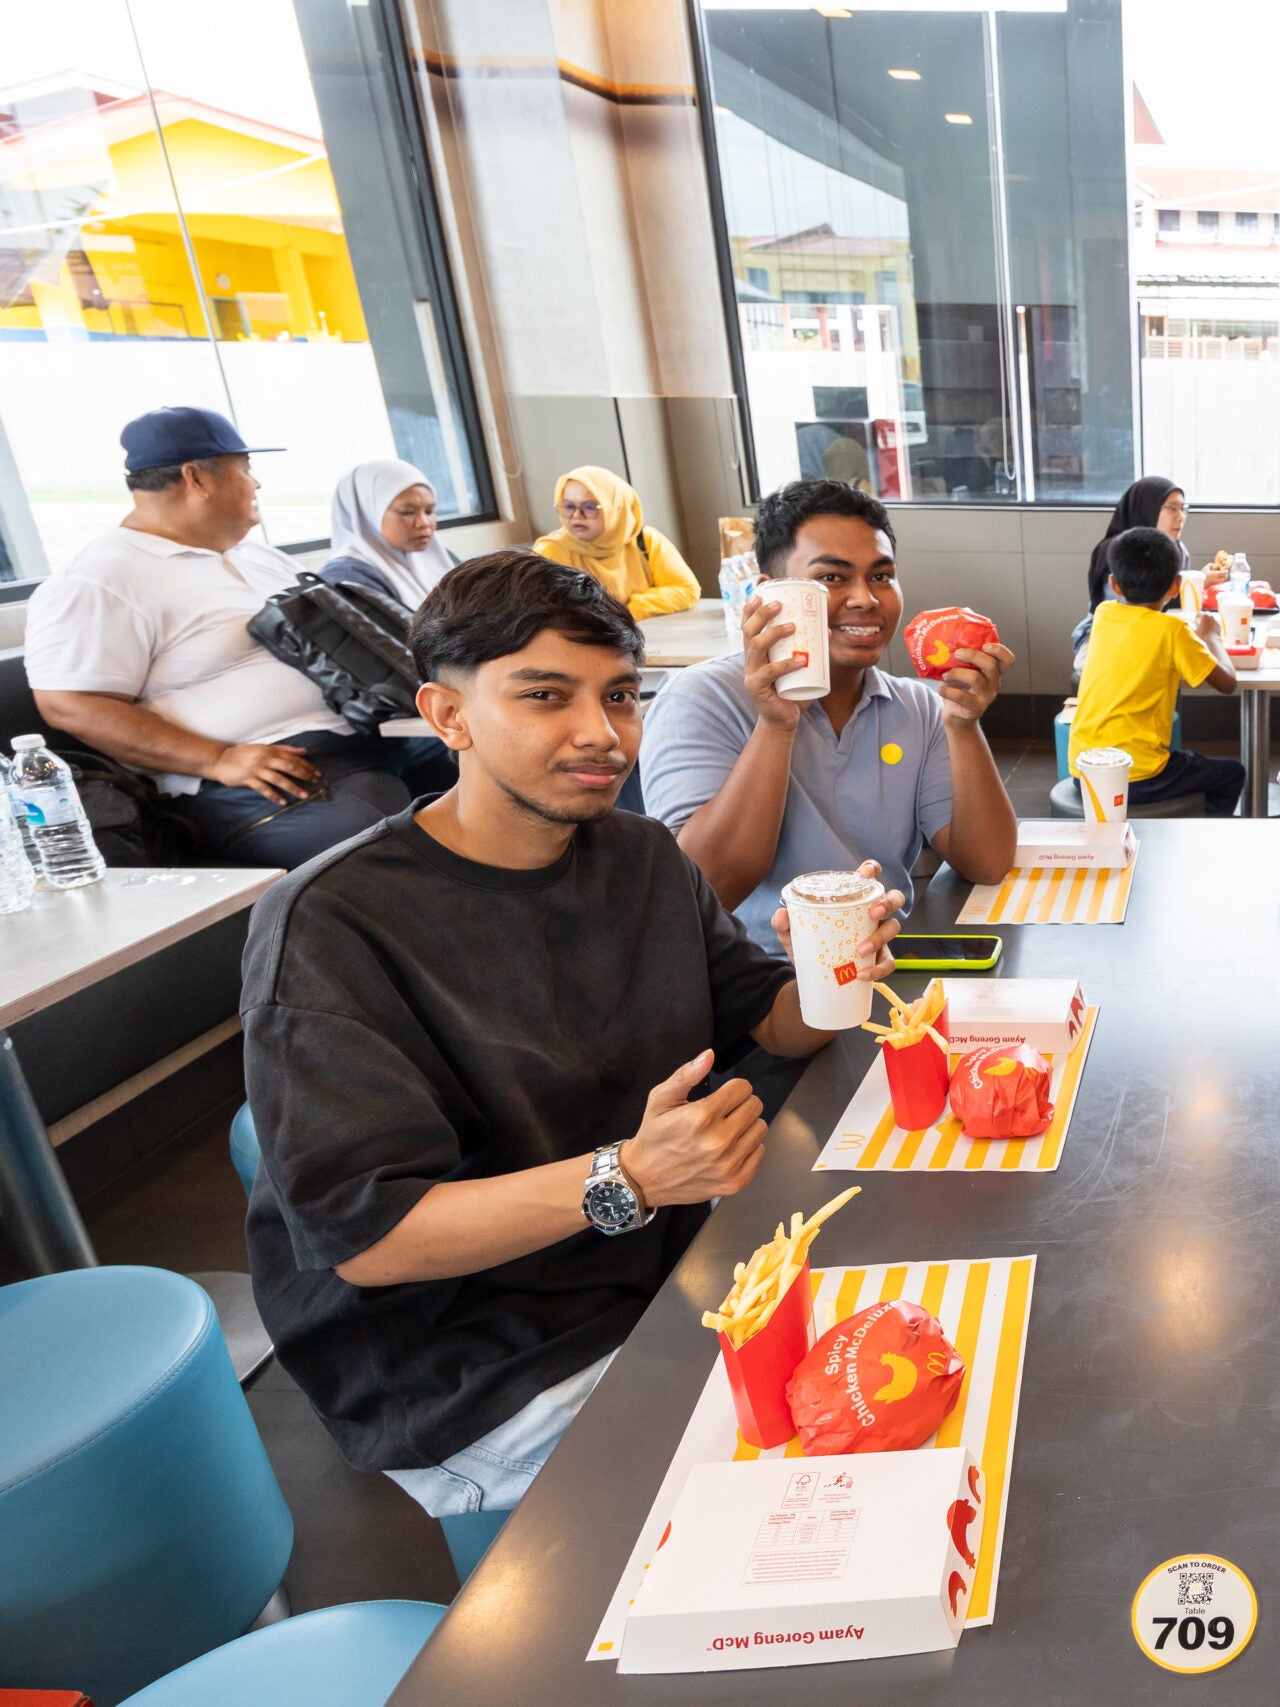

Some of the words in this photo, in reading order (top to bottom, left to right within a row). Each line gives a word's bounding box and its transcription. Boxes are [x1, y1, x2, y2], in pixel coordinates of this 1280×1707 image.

[969, 1034, 1001, 1044] Goreng
[1002, 1035, 1026, 1044] Ayam
[845, 1300, 900, 1361] McDeluxe
[824, 1334, 849, 1377] Spicy
[845, 1360, 876, 1428] Chicken
[1167, 1562, 1188, 1574] SCAN
[1201, 1561, 1227, 1574] ORDER
[1184, 1607, 1206, 1615] Table
[754, 1629, 815, 1647] Goreng
[819, 1625, 865, 1641] Ayam
[1152, 1616, 1235, 1651] 709
